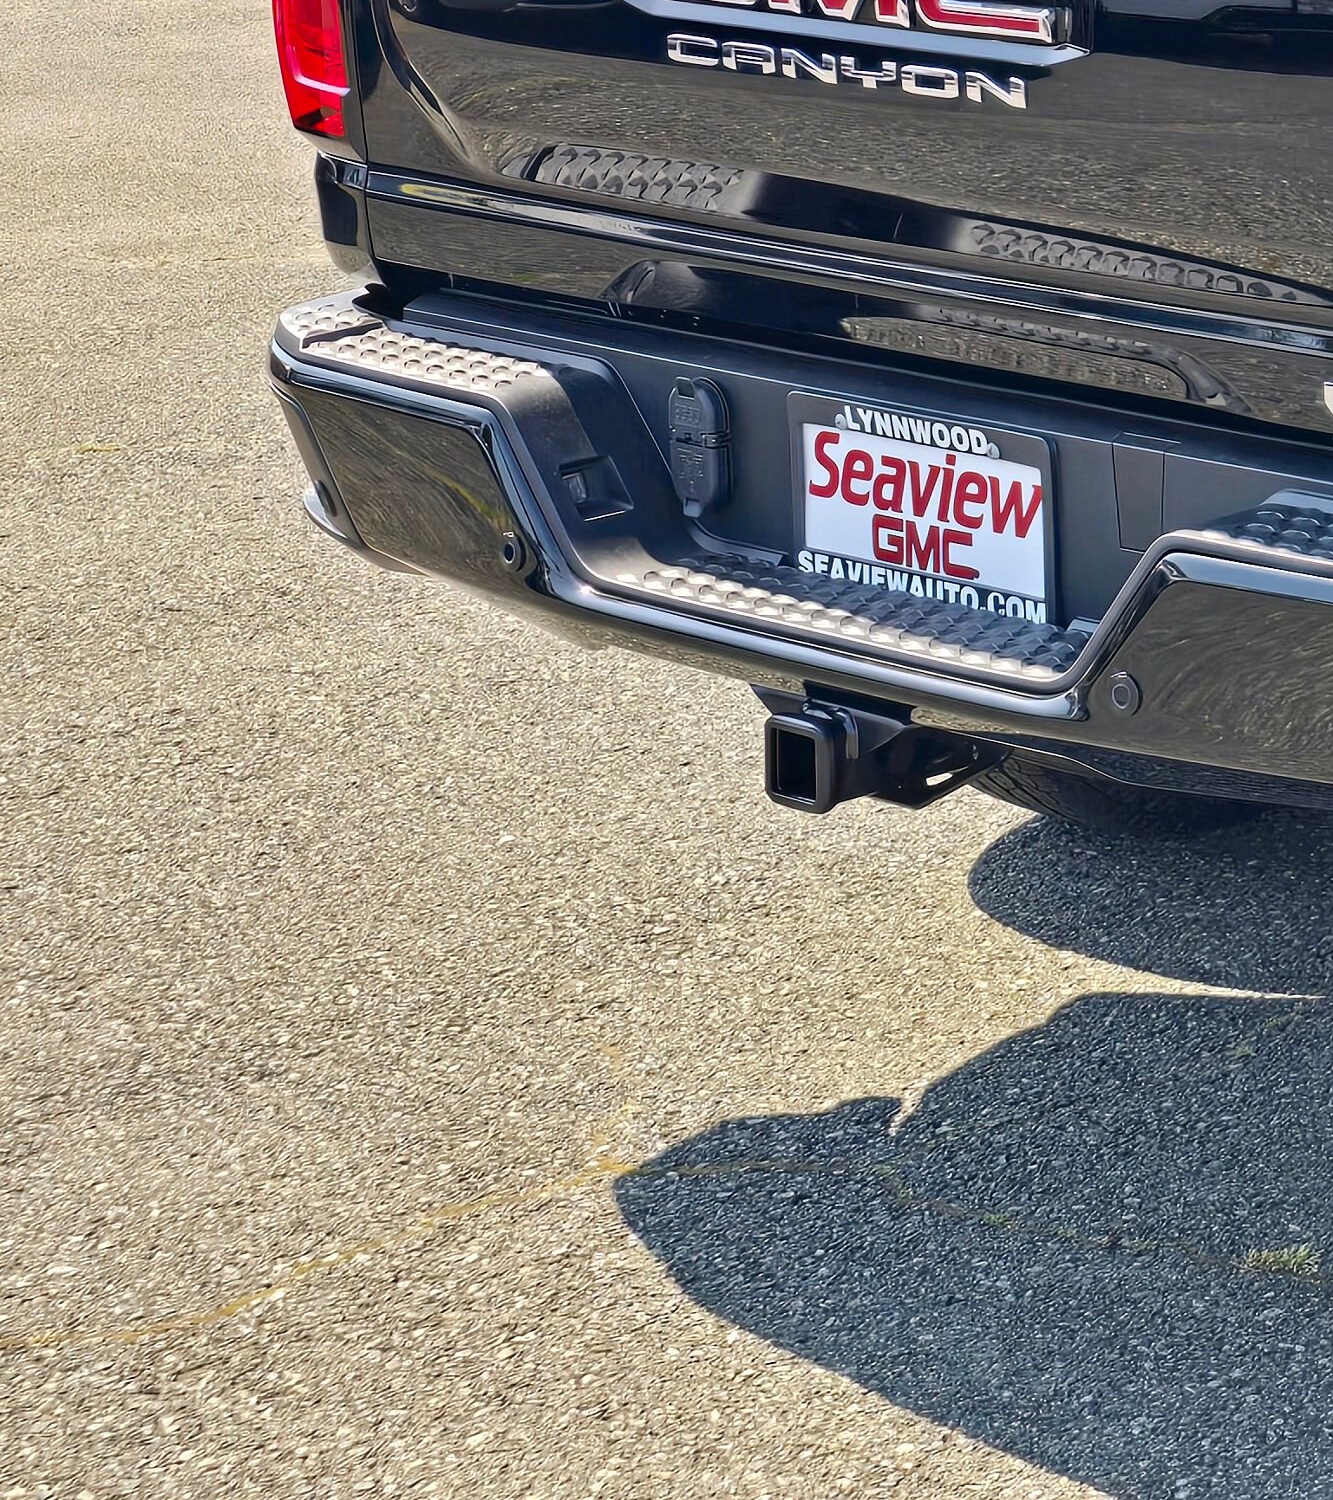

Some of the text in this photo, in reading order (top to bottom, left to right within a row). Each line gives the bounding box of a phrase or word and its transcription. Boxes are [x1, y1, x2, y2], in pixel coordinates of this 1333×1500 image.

[665, 33, 1027, 109] CANYON
[844, 404, 988, 456] LYNNWOOD
[808, 431, 1043, 539] Seaview
[871, 513, 980, 580] GMC
